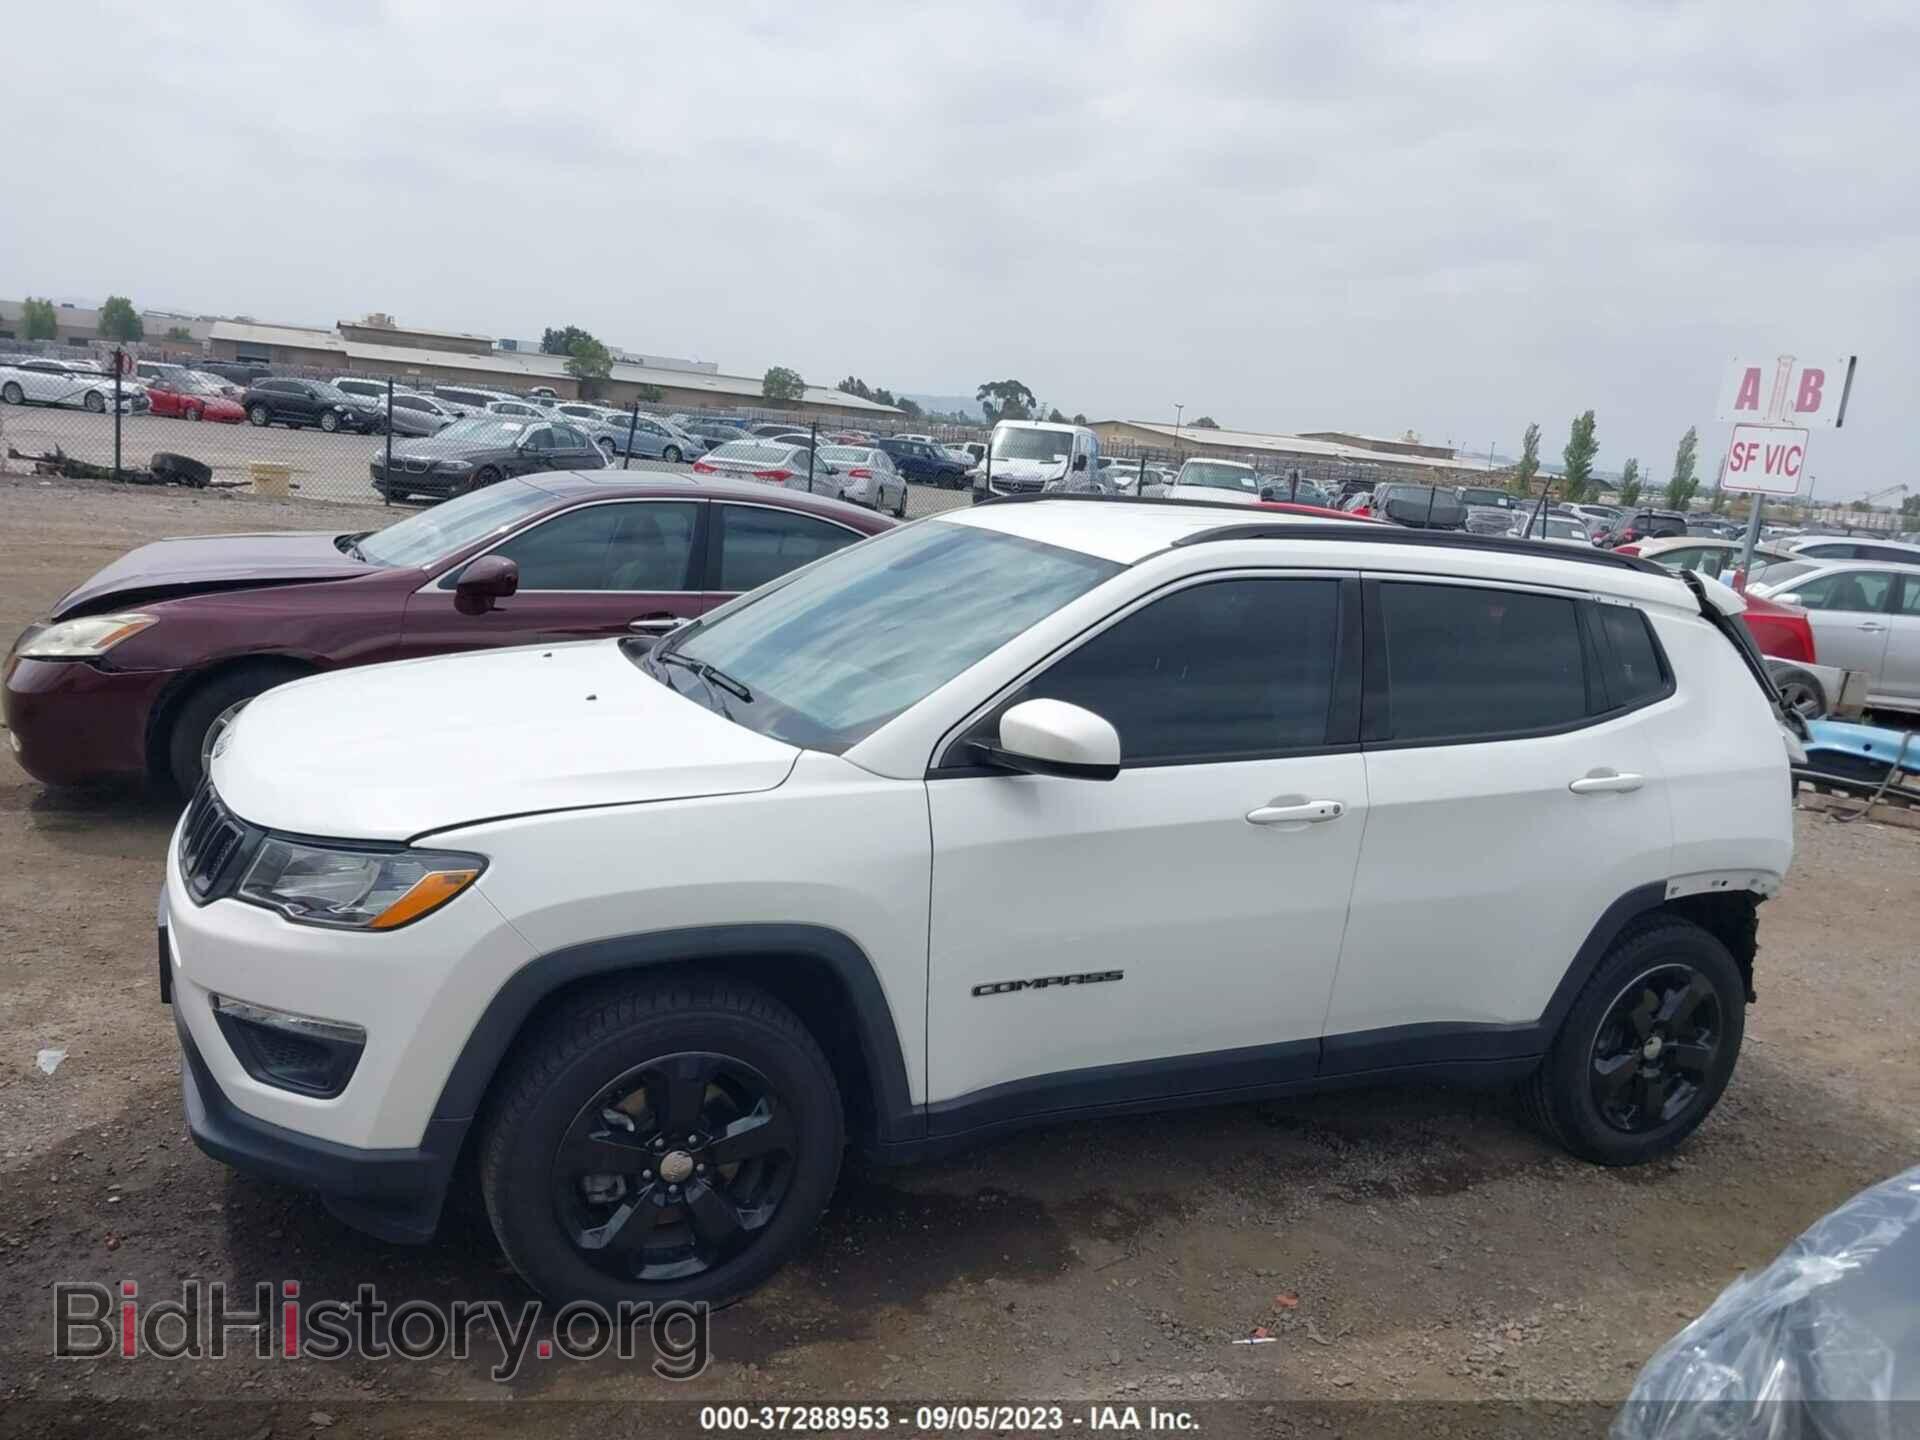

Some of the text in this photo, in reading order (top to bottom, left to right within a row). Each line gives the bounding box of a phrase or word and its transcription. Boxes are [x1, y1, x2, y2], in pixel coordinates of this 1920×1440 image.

[1734, 368, 1825, 412] A B
[1730, 442, 1802, 477] SF VIC
[972, 970, 1124, 997] COMPASS
